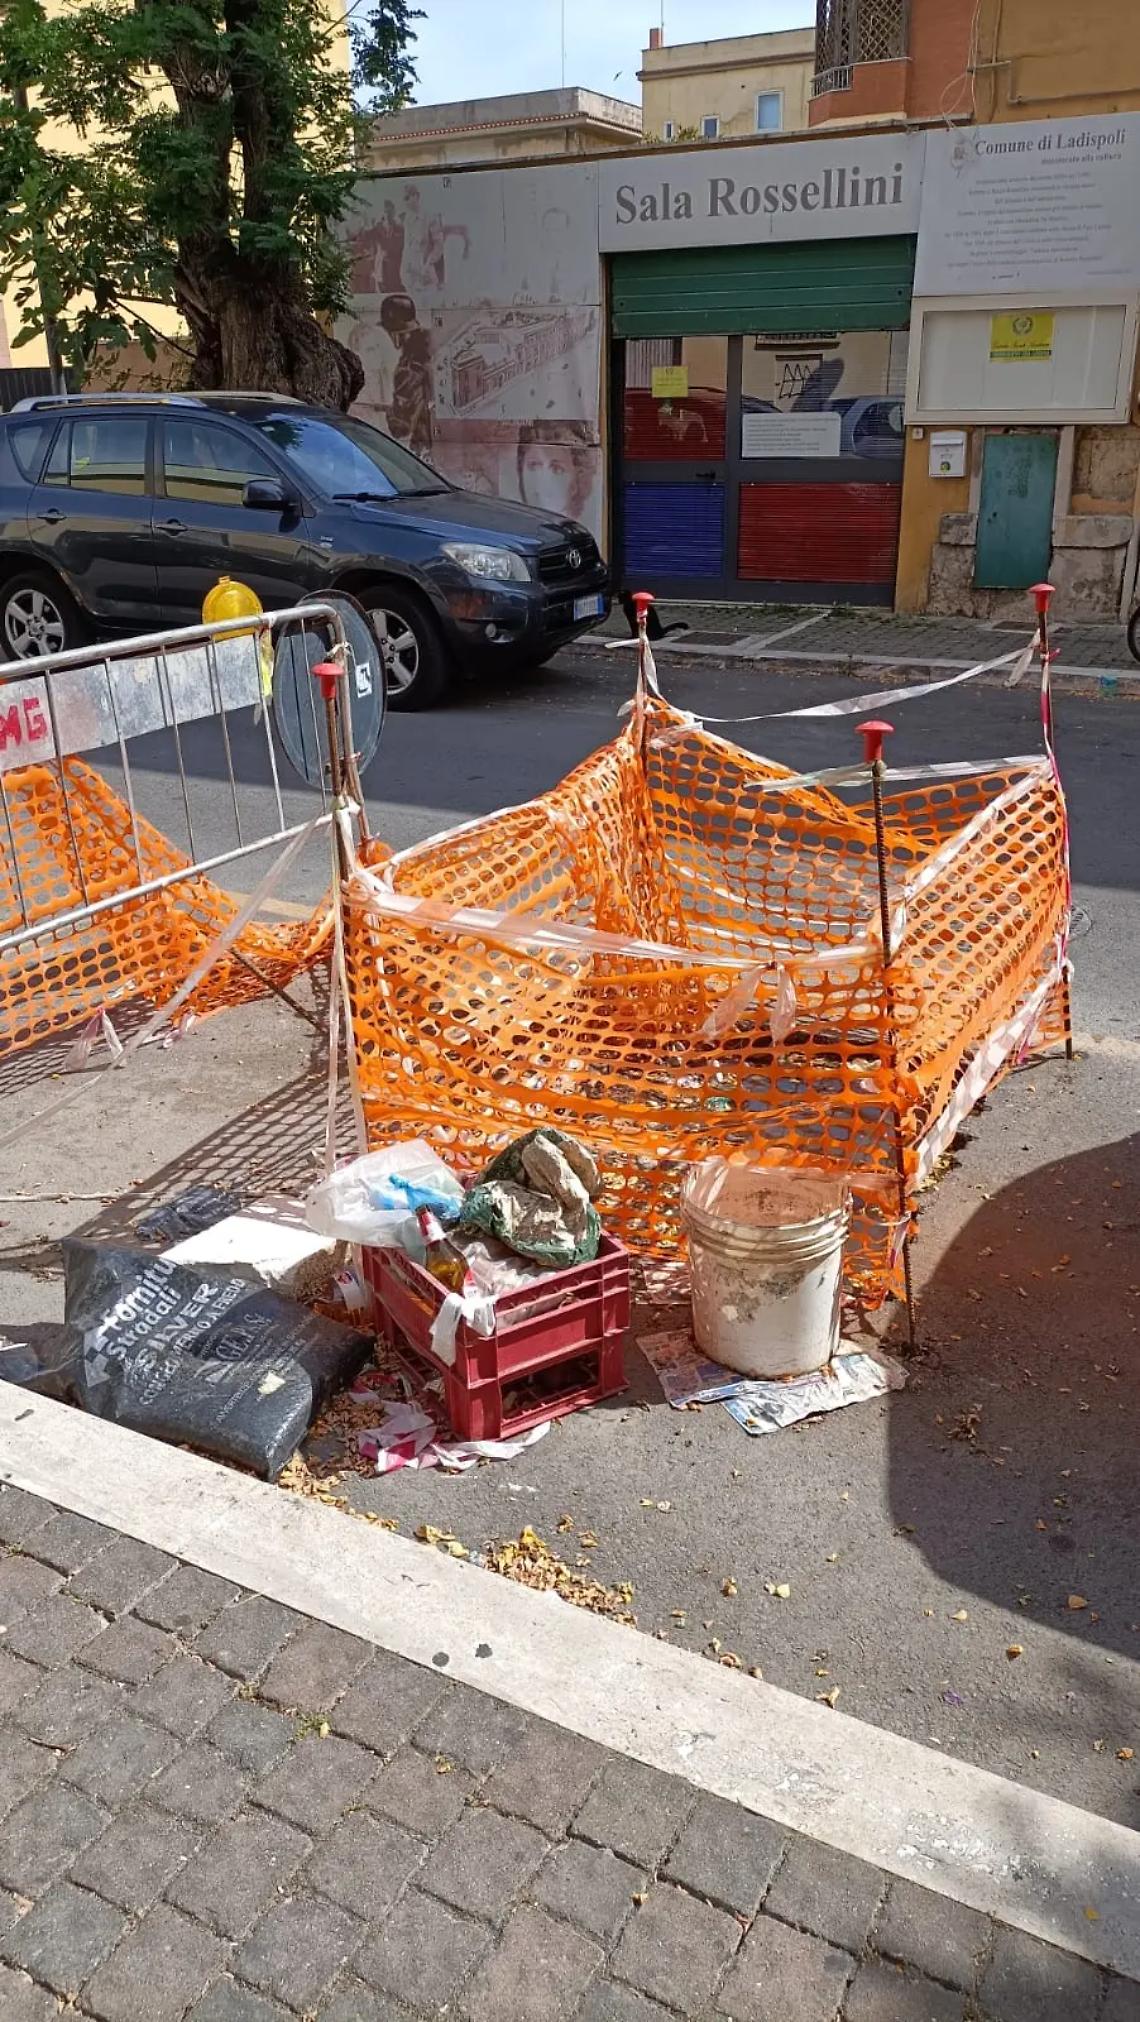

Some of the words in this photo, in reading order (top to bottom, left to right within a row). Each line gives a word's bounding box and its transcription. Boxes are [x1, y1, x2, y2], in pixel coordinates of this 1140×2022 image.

[975, 140, 1034, 156] Comune
[1038, 132, 1052, 151] di
[1057, 128, 1126, 151] Ladispoli
[616, 182, 693, 224] Sala
[707, 162, 903, 217] Rossellini
[106, 1285, 182, 1361] Stradali
[135, 1283, 219, 1372] SILVER
